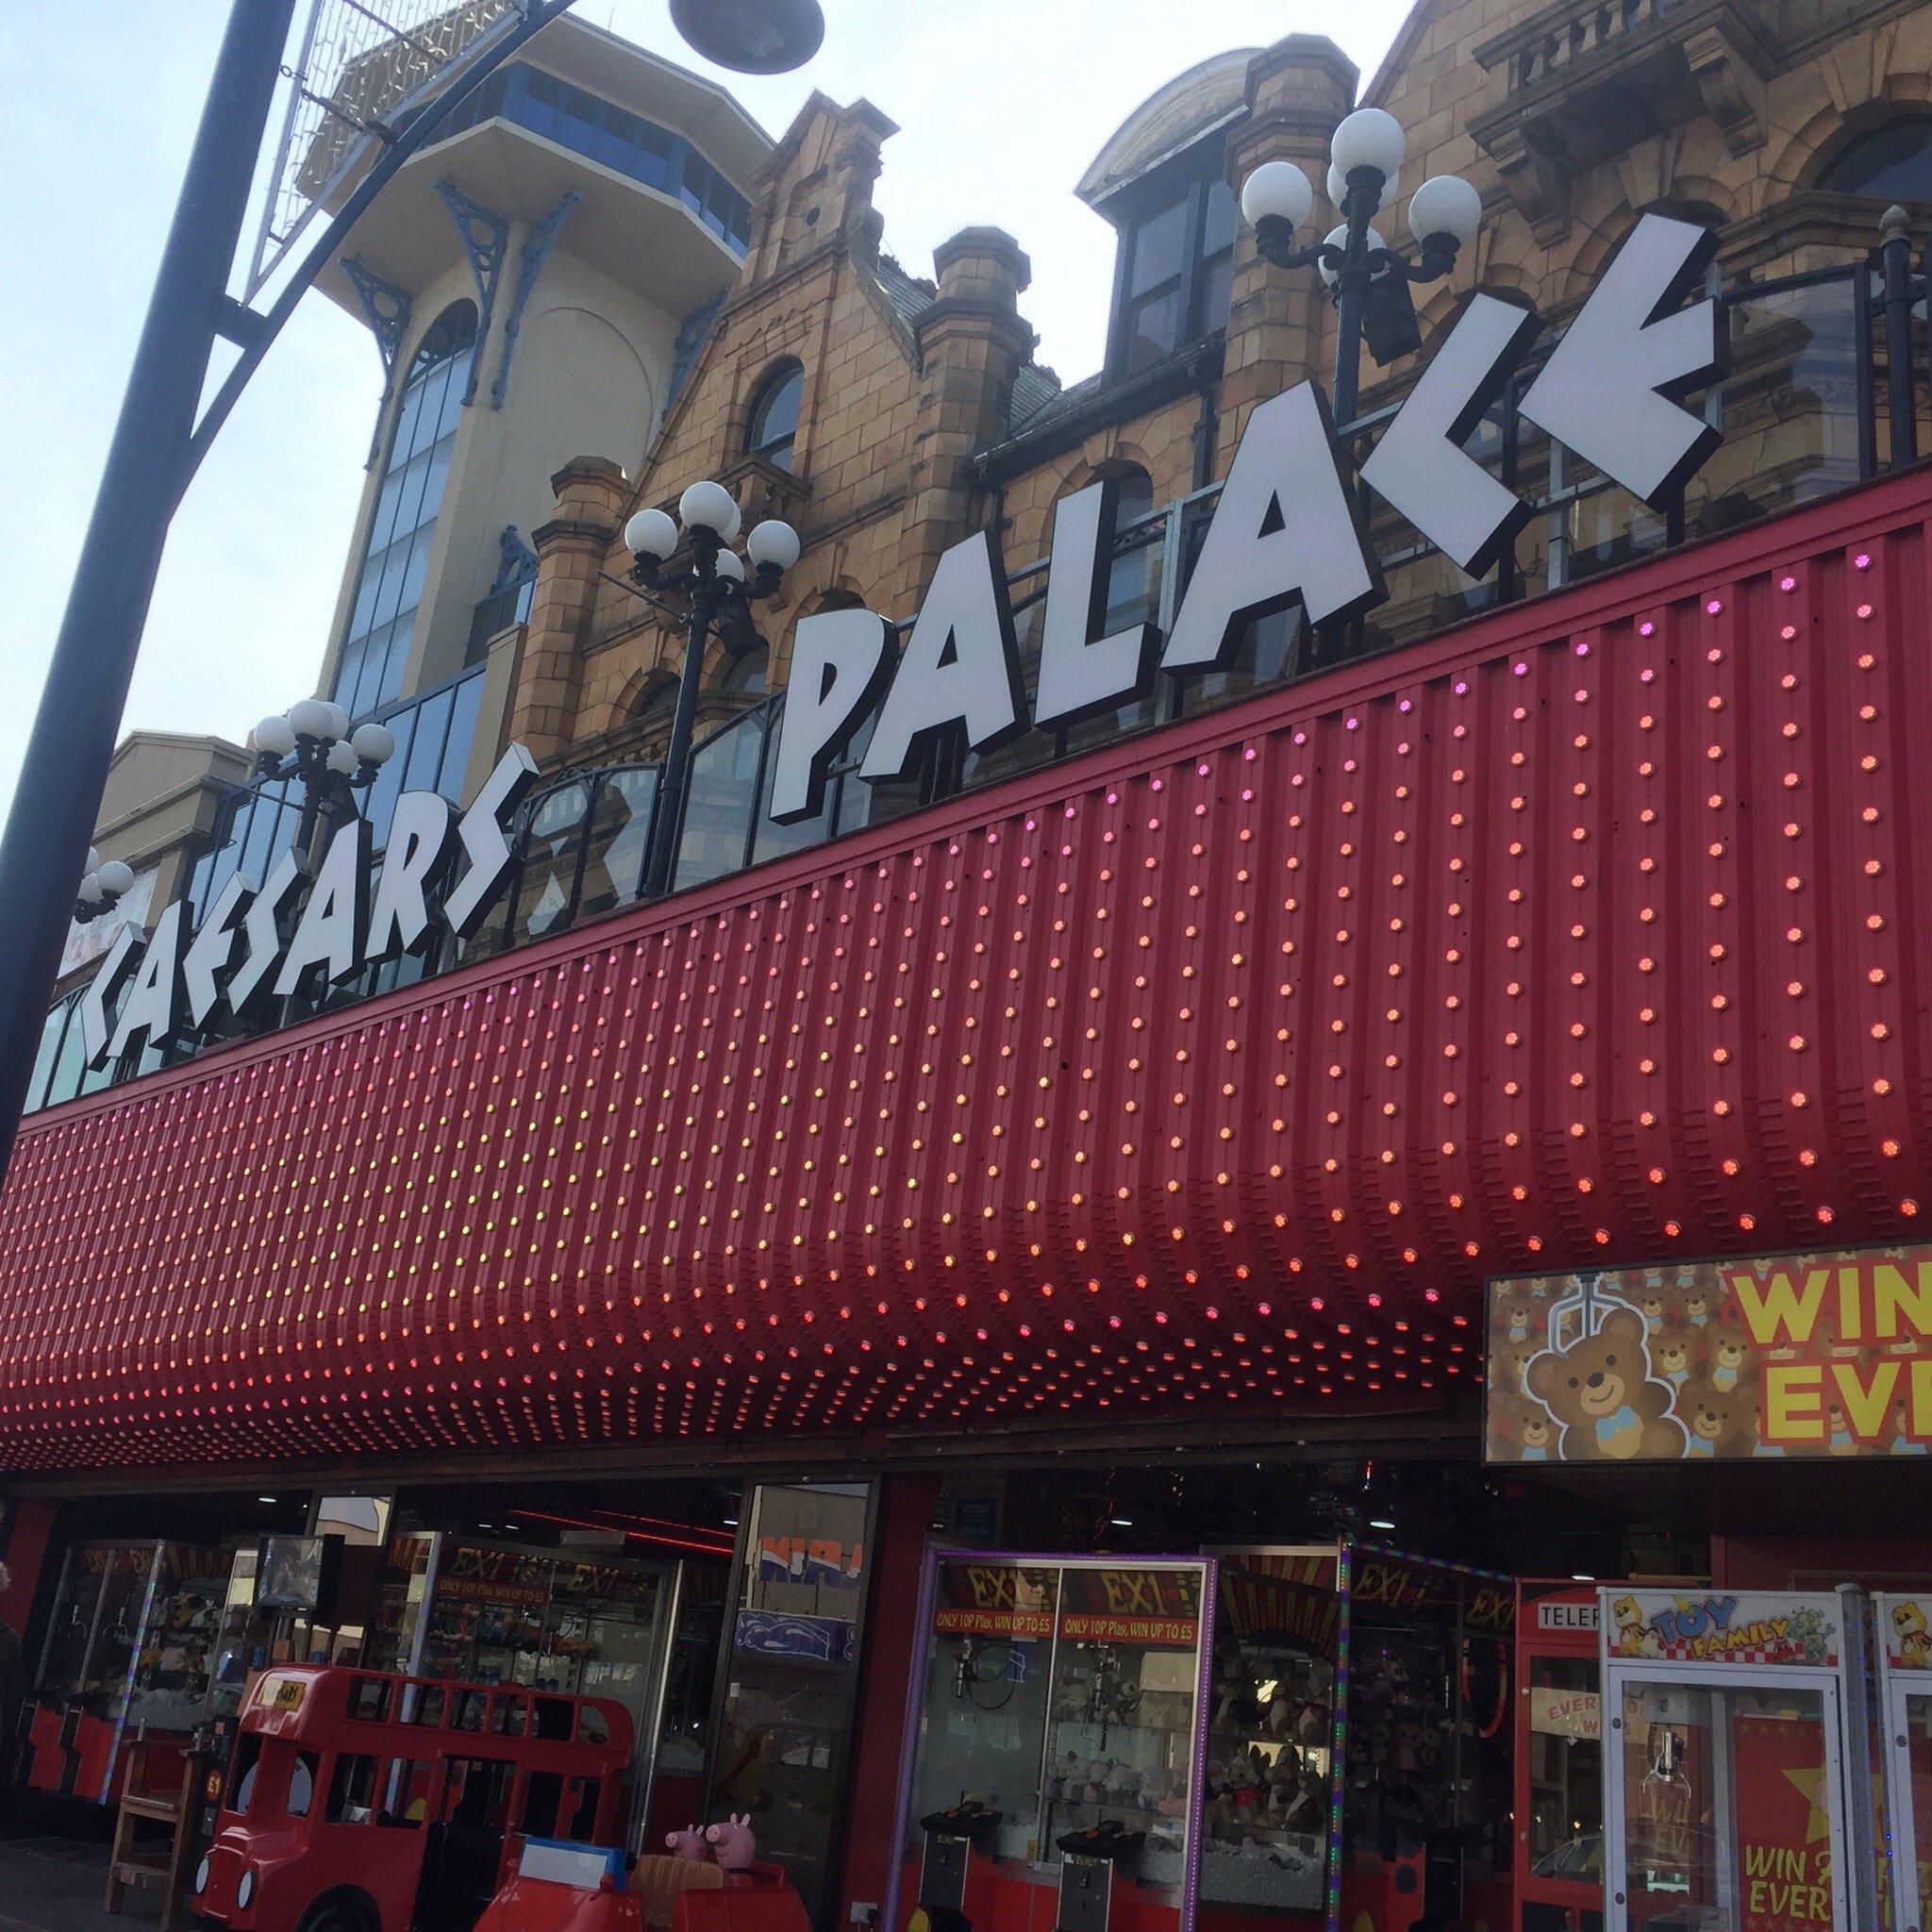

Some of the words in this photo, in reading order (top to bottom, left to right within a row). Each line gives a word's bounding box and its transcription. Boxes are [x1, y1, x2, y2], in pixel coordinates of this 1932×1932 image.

[81, 741, 540, 1073] CAESARS
[768, 213, 1727, 825] PALACE
[1732, 1261, 1932, 1344] WIN
[937, 1612, 958, 1627] ONLY
[960, 1614, 974, 1628] 10P
[995, 1615, 1012, 1630] WIN
[1012, 1616, 1025, 1631] UP
[1026, 1617, 1038, 1632] TO
[1039, 1618, 1050, 1633] £5
[1065, 1620, 1089, 1635] ONLY
[1091, 1621, 1108, 1636] 10P
[1130, 1622, 1148, 1638] WIN
[1150, 1623, 1164, 1638] UP
[1166, 1623, 1179, 1640] TO
[1180, 1624, 1193, 1641] £5
[1651, 1596, 1739, 1643] TOY
[1691, 1617, 1790, 1658] FAMILY
[1745, 1843, 1807, 1885] WIN
[1750, 1880, 1831, 1922] EVER
